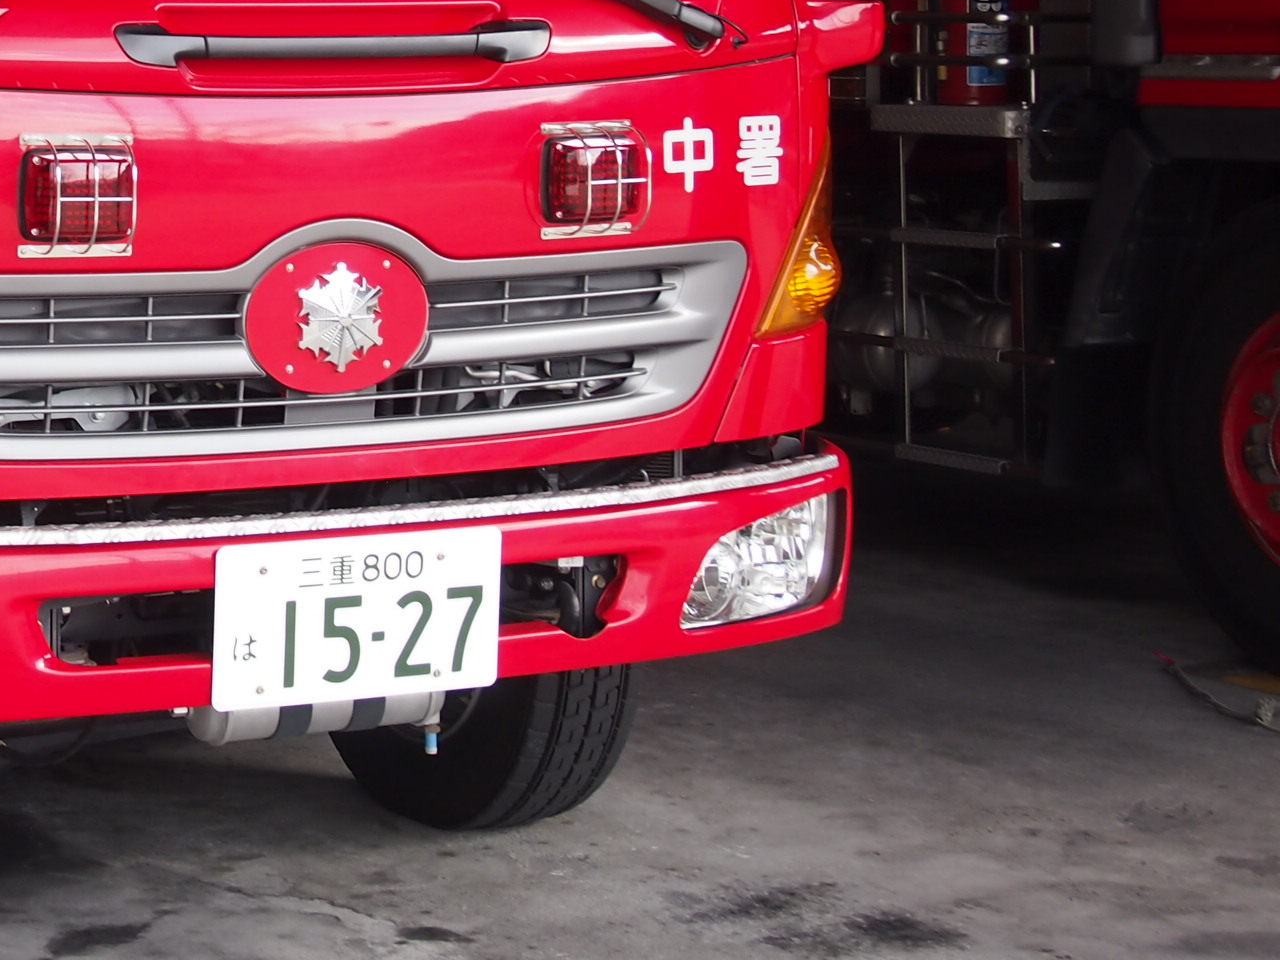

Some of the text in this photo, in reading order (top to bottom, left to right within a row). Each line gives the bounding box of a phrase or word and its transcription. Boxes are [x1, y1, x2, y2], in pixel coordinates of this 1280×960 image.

[663, 115, 784, 193] 中署
[298, 550, 424, 588] 三重800
[232, 585, 484, 689] は 15-27
